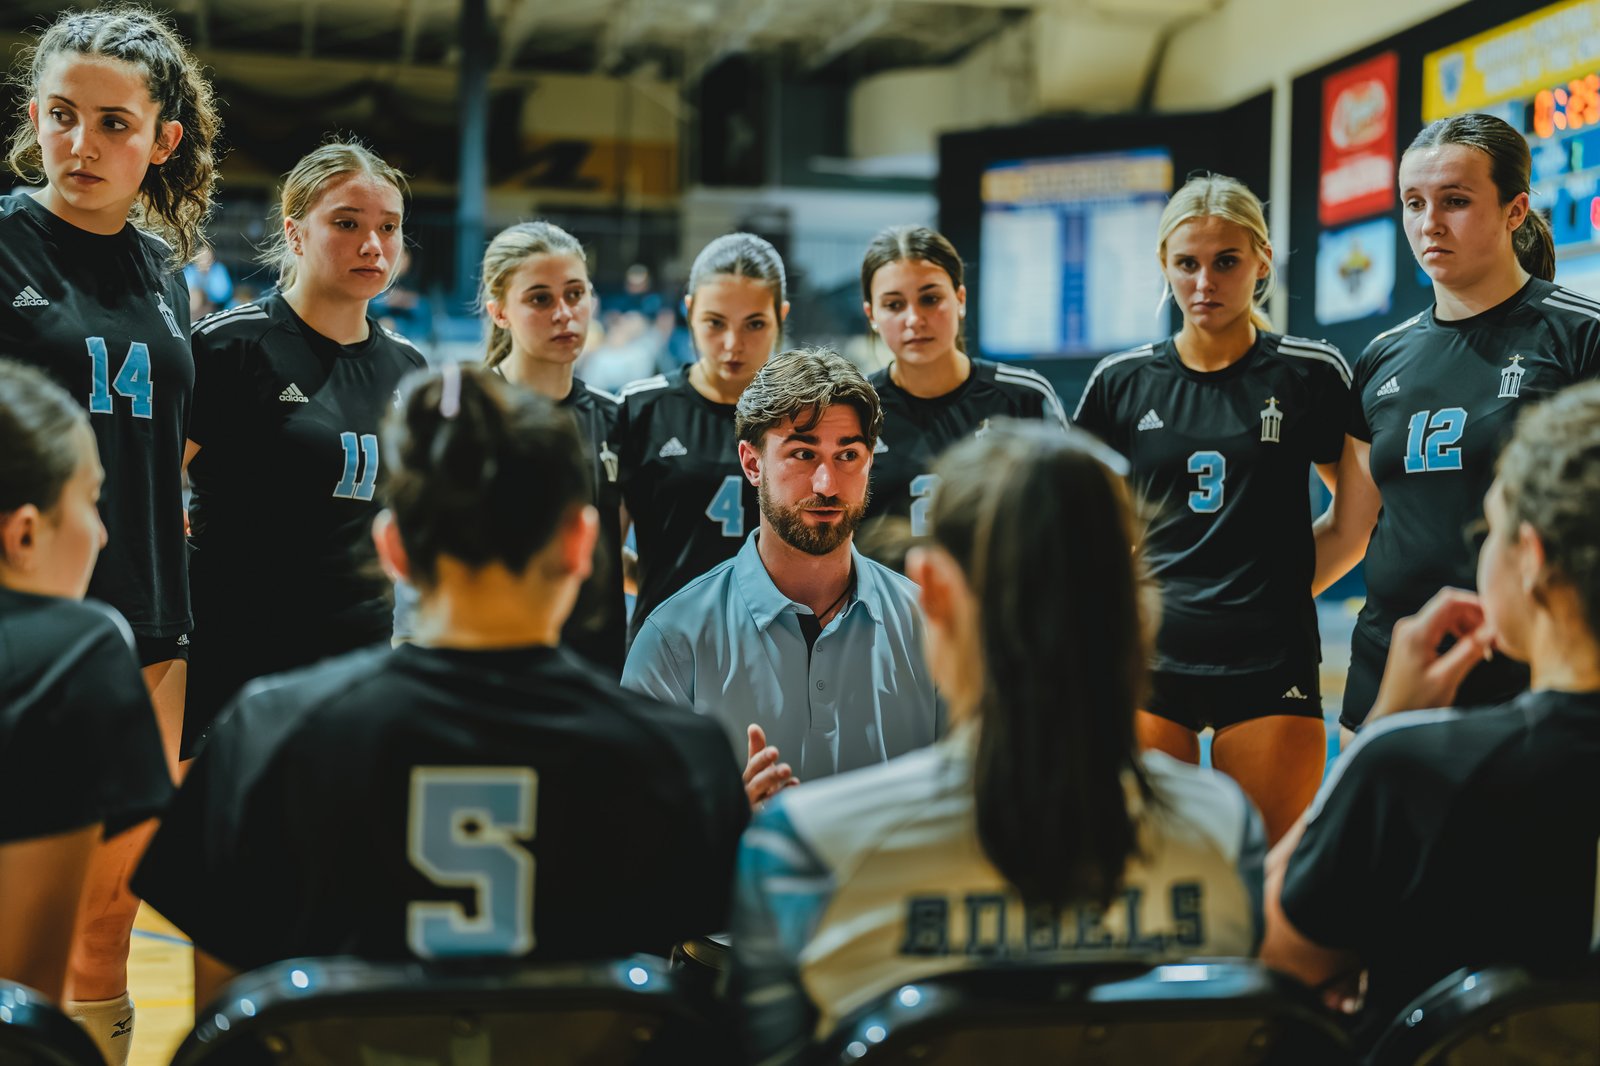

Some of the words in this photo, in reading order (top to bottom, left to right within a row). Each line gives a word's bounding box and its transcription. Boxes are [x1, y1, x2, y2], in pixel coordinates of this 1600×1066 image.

[12, 298, 50, 307] adidas
[85, 337, 153, 419] 14
[278, 394, 309, 403] adidas
[332, 431, 380, 502] 11
[1403, 407, 1468, 474] 12
[705, 475, 744, 538] 4
[1187, 450, 1226, 514] 3
[407, 766, 538, 959] 5
